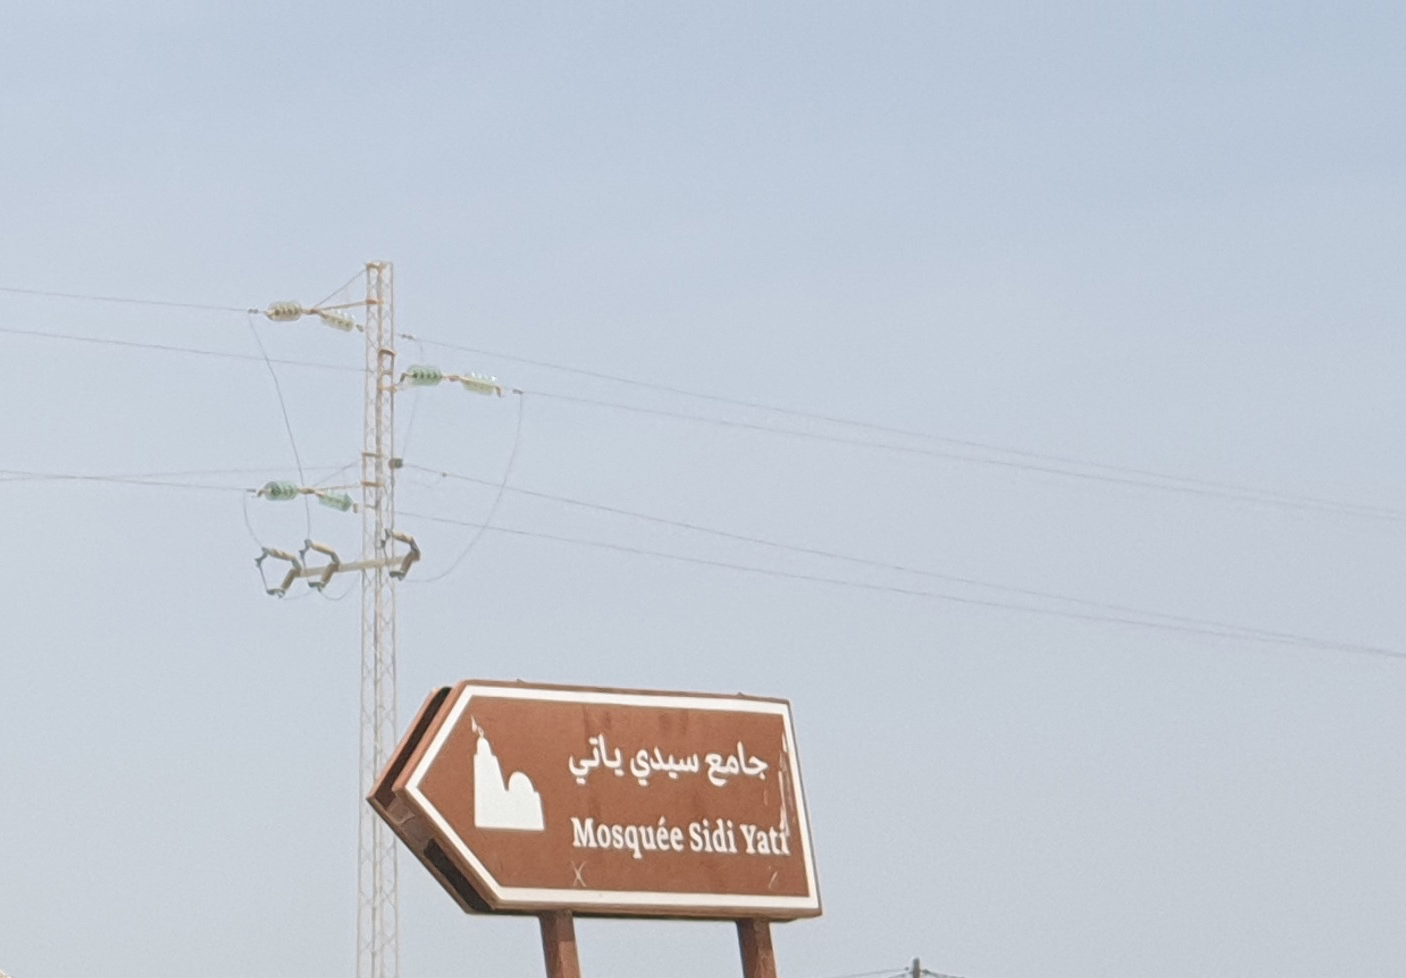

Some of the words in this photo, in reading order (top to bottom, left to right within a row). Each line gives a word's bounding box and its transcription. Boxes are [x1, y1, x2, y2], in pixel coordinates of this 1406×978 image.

[568, 733, 624, 785] ياتي
[630, 746, 700, 787] سيدي
[705, 740, 769, 787] جامع
[570, 815, 685, 860] Mosquée
[688, 818, 738, 854] Sidi
[740, 824, 791, 856] Yati
